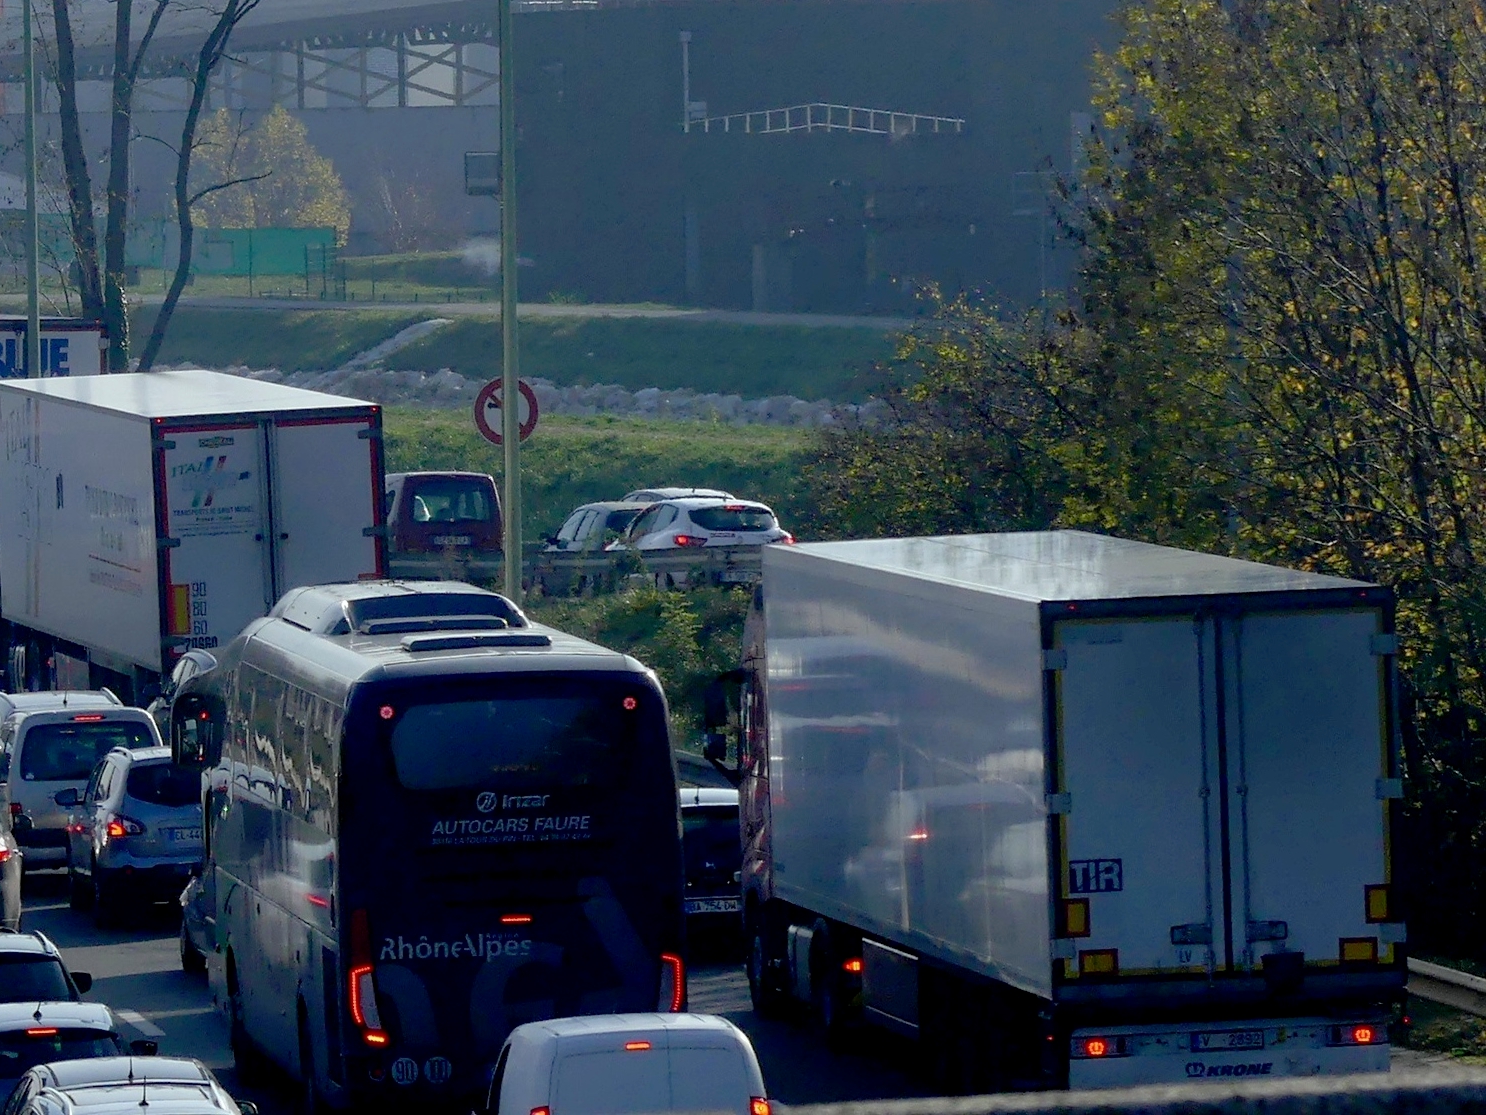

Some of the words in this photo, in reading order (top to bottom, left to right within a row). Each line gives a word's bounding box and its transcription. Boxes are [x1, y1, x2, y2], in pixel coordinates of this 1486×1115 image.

[193, 601, 207, 616] 80
[194, 620, 208, 635] 60
[431, 817, 529, 835] AUTOCARS
[534, 815, 591, 831] FAURE
[1070, 861, 1120, 891] TIR
[1207, 1062, 1273, 1077] KRONE
